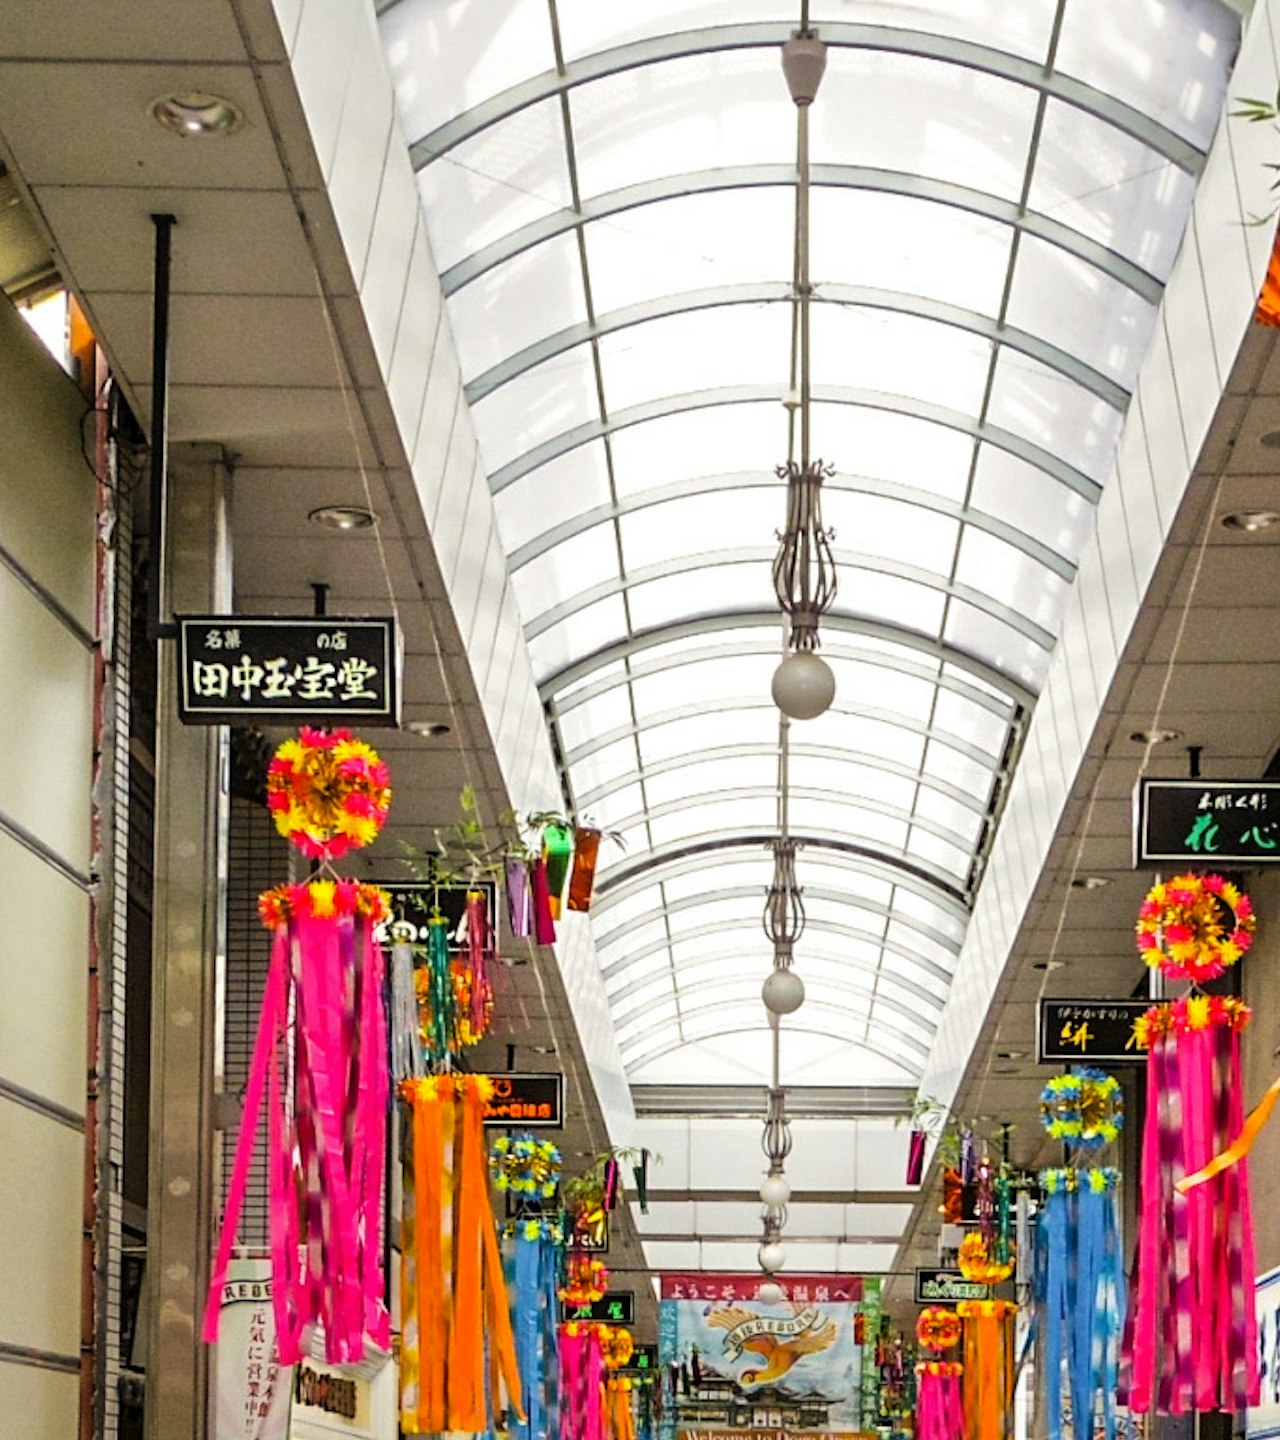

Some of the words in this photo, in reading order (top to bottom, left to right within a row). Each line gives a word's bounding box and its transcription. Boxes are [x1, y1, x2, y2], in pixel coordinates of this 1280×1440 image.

[204, 628, 243, 650] 名菓
[316, 629, 348, 651] の店
[192, 653, 378, 701] 田中玉宝堂
[670, 1283, 851, 1301] ようこそ、温泉へ
